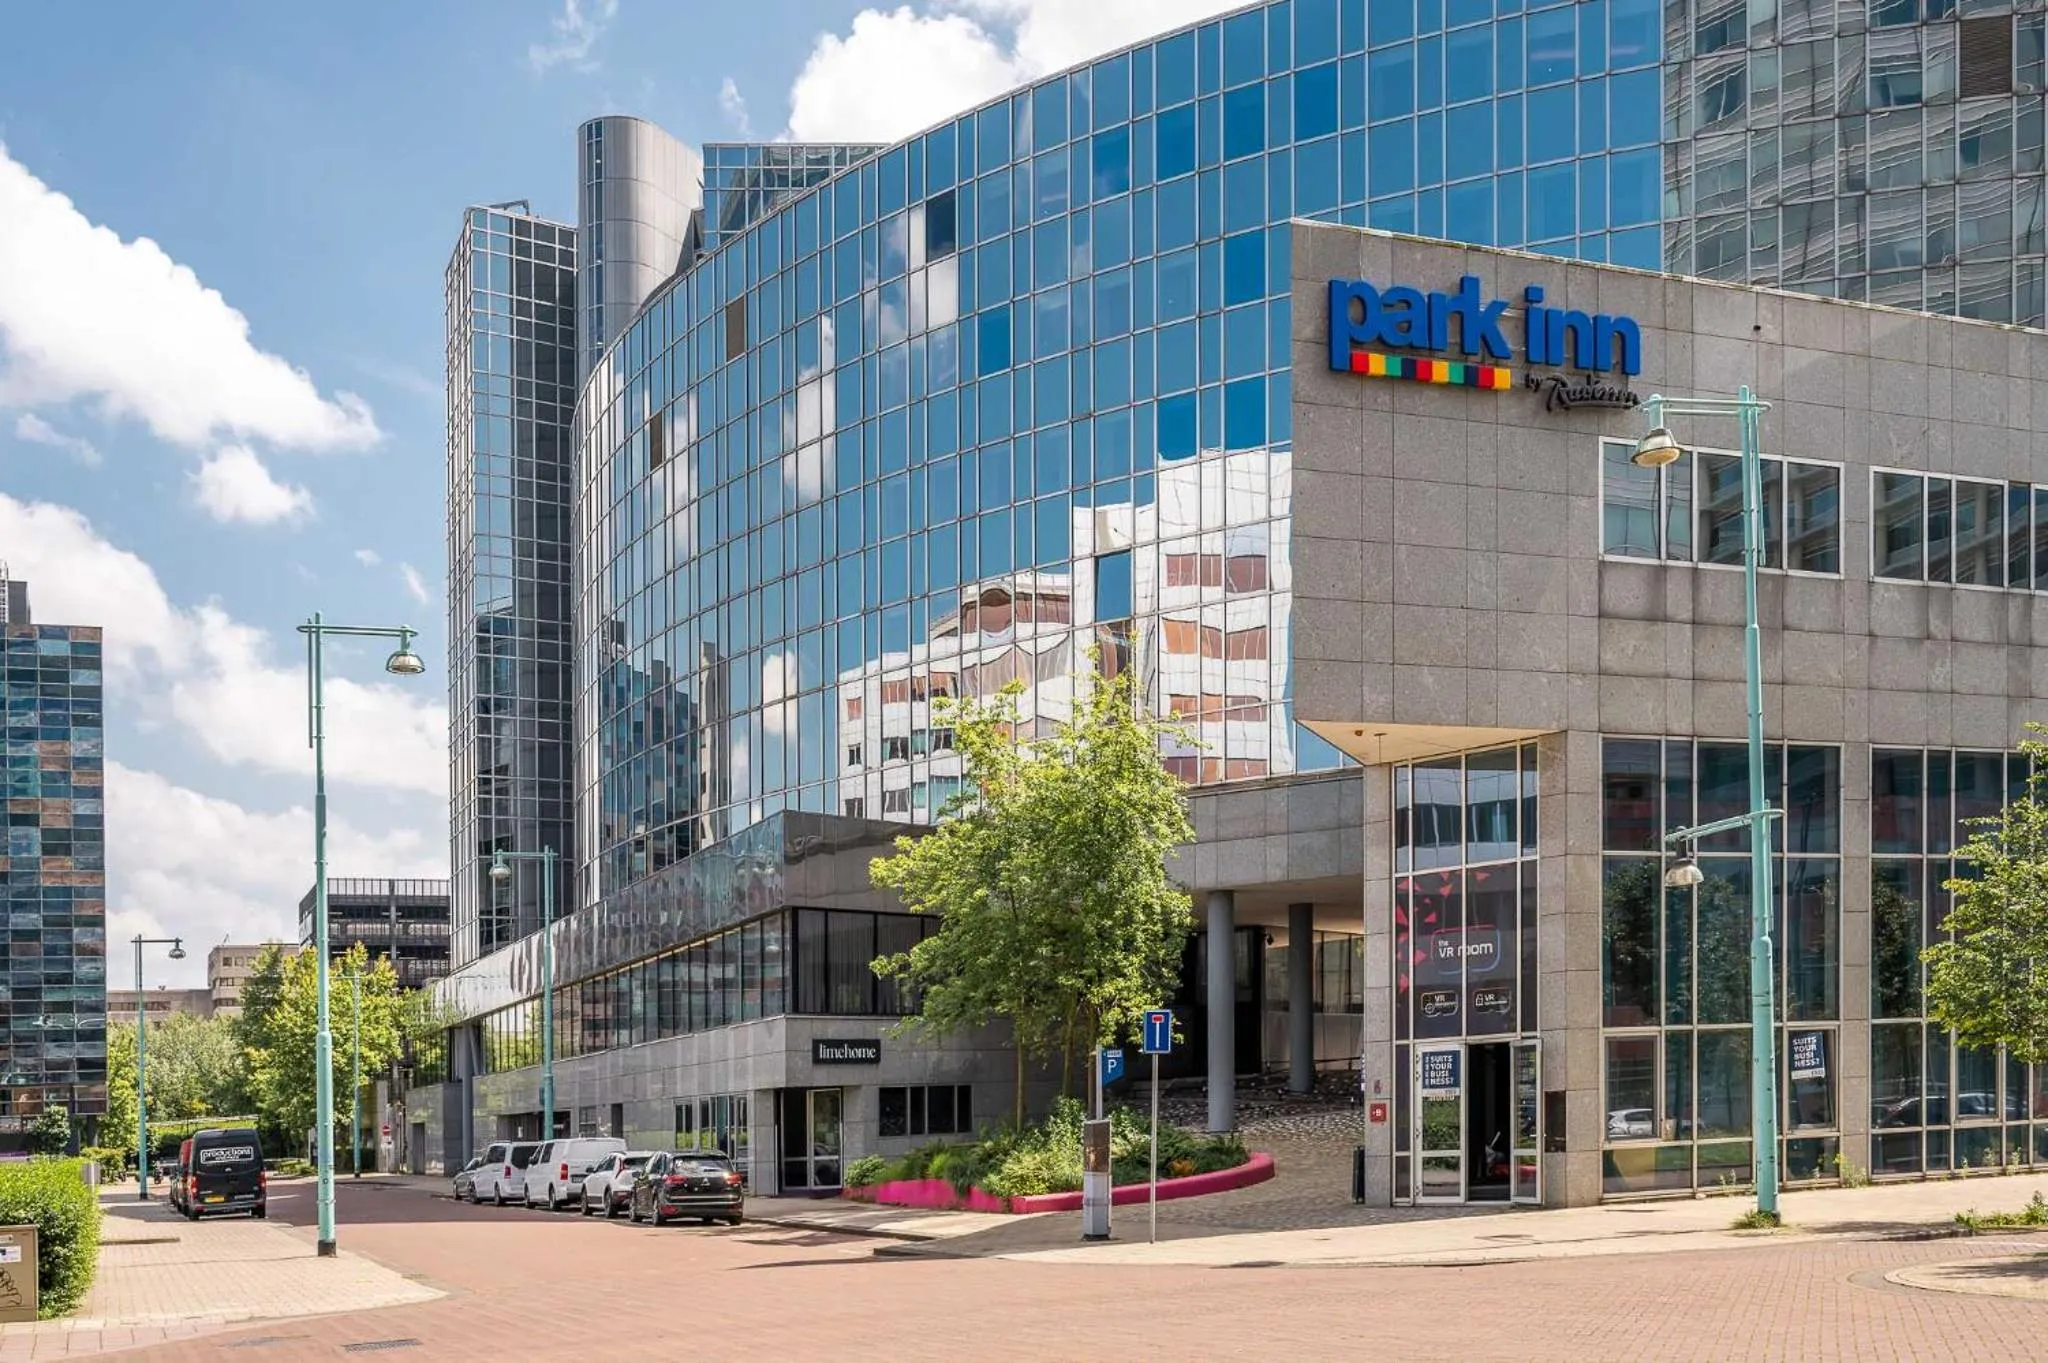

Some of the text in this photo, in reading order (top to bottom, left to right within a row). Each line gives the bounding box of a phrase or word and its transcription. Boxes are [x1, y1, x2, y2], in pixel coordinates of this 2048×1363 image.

[1328, 275, 1641, 376] park inn
[1524, 373, 1543, 393] by
[1439, 947, 1454, 958] VR
[1484, 993, 1495, 1002] VR
[1792, 1036, 1817, 1046] SUITS
[820, 1043, 876, 1059] limehome
[1793, 1045, 1817, 1053] YOUR
[1430, 1055, 1453, 1063] SUITS
[1108, 1059, 1117, 1073] P
